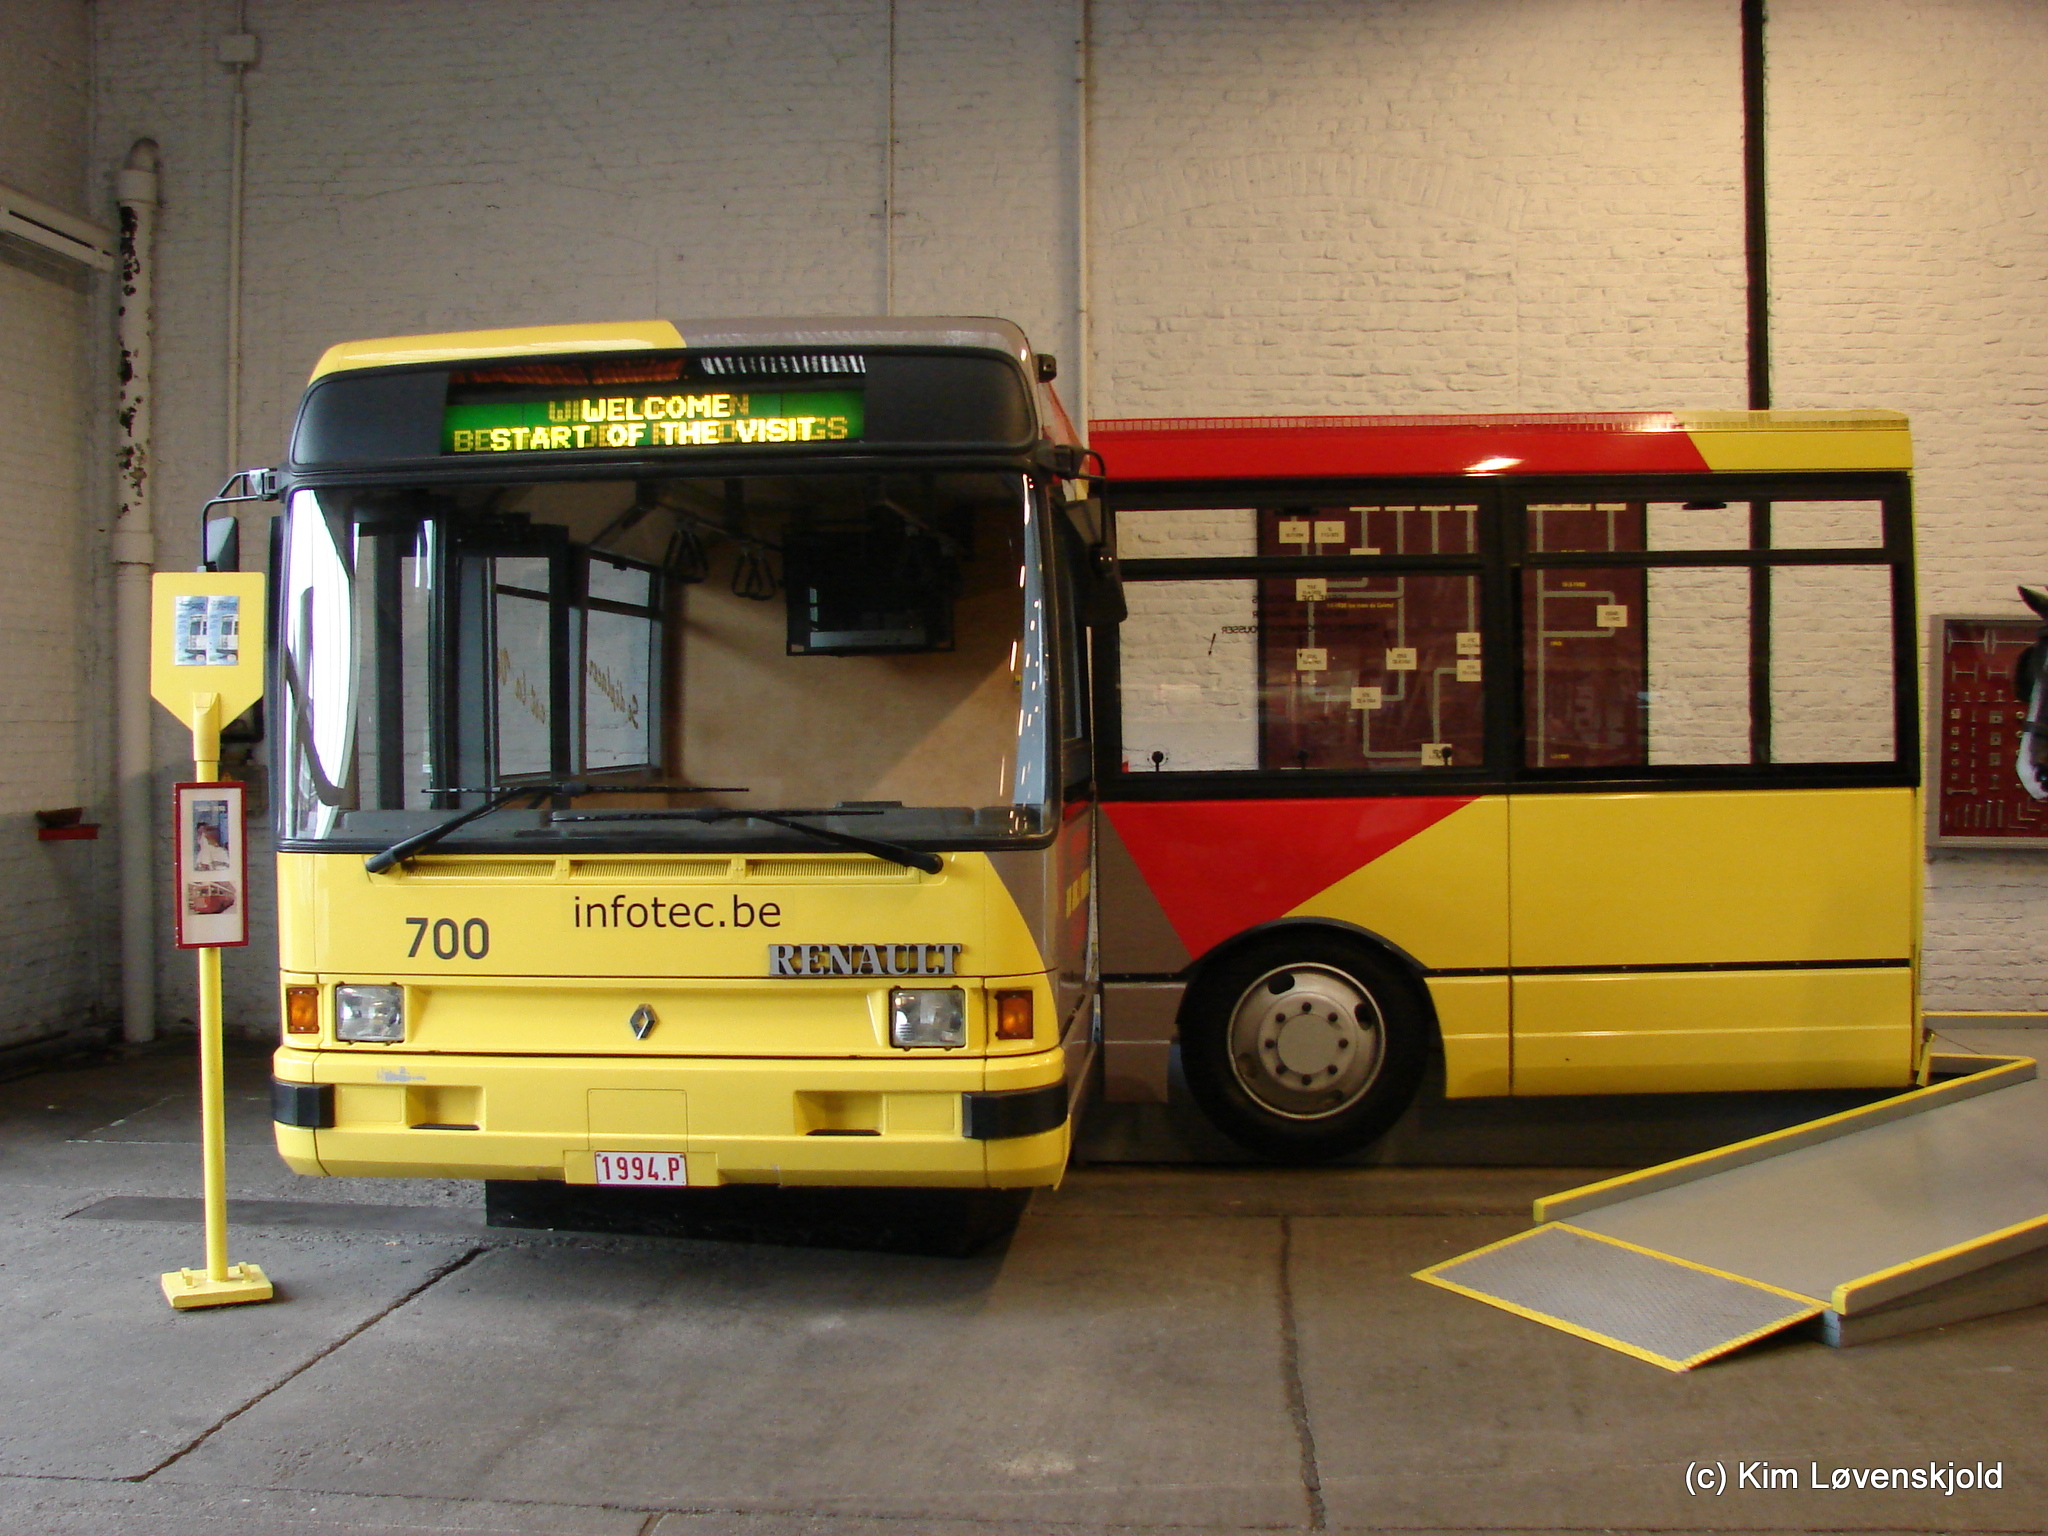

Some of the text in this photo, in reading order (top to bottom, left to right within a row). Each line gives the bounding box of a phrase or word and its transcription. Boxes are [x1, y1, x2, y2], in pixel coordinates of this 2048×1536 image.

[582, 393, 731, 423] WELCOME
[490, 424, 591, 452] START
[606, 422, 648, 448] OF
[659, 420, 722, 446] THE
[735, 415, 817, 444] VISIT
[575, 894, 781, 928] infotec.be
[406, 917, 489, 960] 700
[769, 943, 963, 978] RENAULT
[602, 1156, 680, 1181] 1994.P
